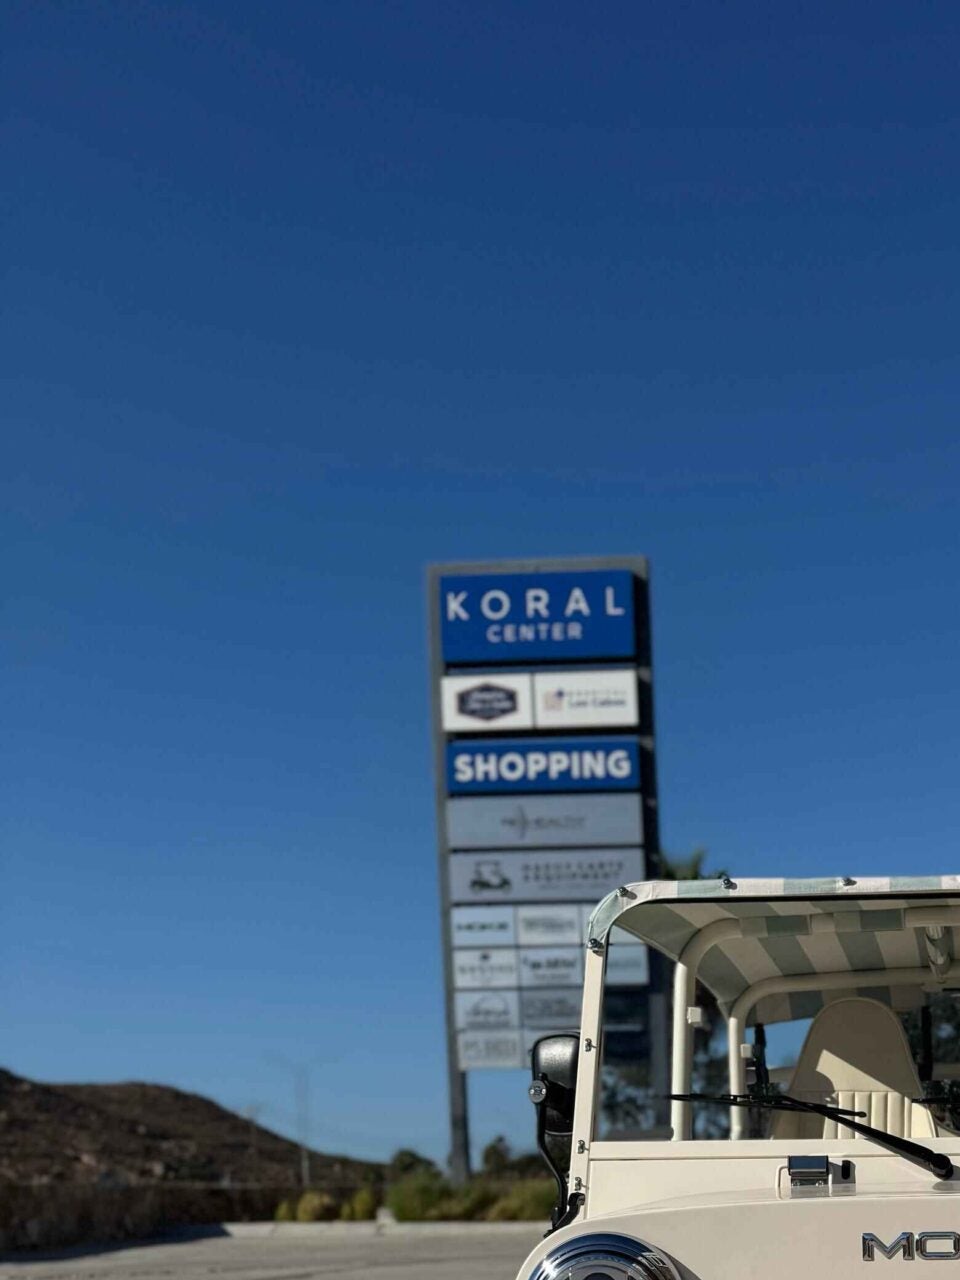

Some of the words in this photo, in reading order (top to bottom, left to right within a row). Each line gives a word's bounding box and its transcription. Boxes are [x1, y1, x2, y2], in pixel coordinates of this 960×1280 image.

[446, 586, 625, 621] KORAL
[486, 621, 582, 643] CENTER
[454, 750, 631, 782] SHOPPING
